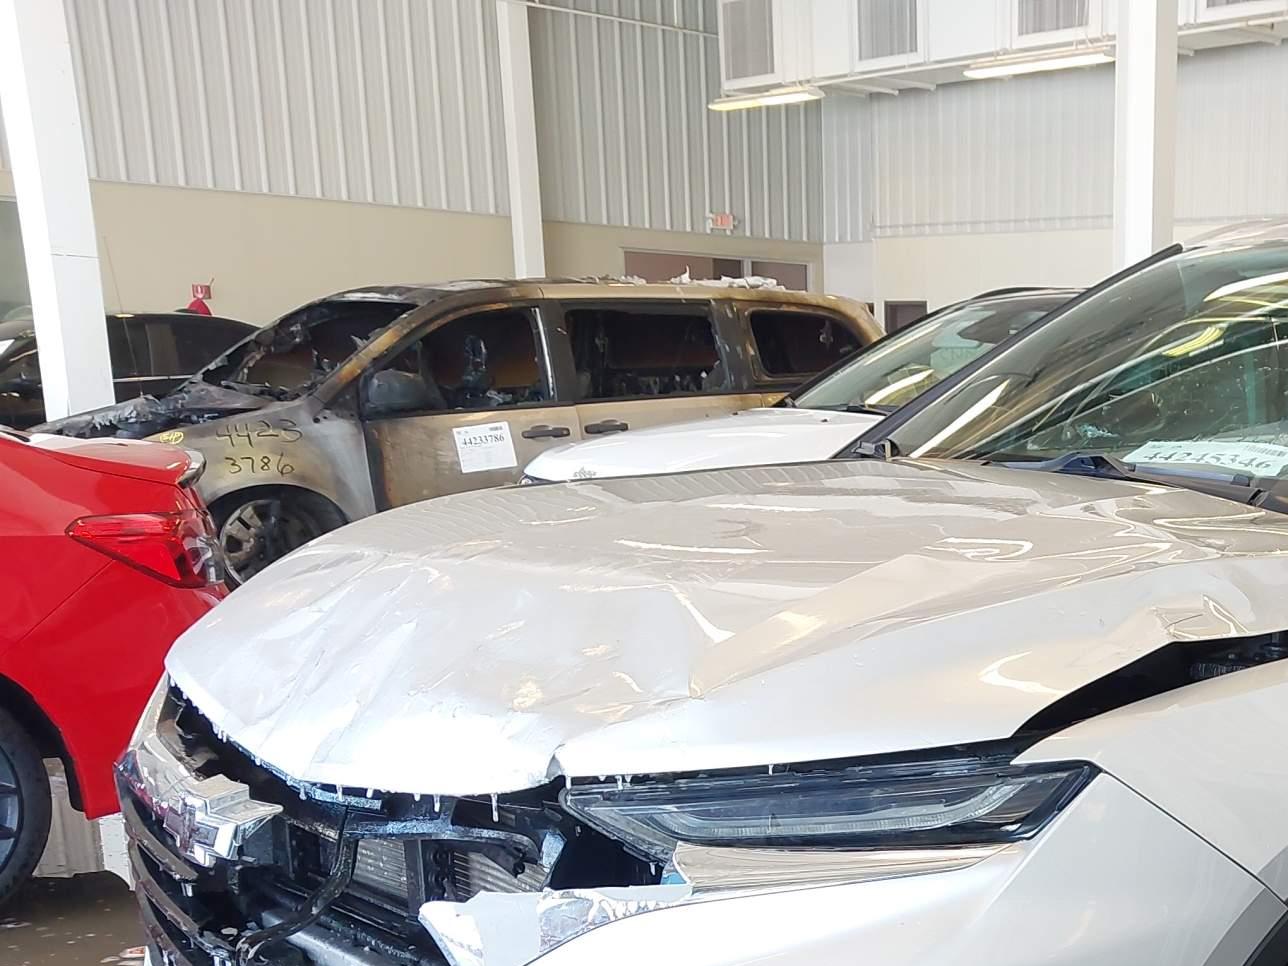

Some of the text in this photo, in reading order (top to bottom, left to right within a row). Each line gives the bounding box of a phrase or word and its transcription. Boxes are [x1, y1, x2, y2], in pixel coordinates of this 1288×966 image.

[215, 418, 303, 448] 4423
[462, 433, 505, 446] 44233786
[224, 451, 296, 477] 3786
[1143, 450, 1274, 469] 44245346
